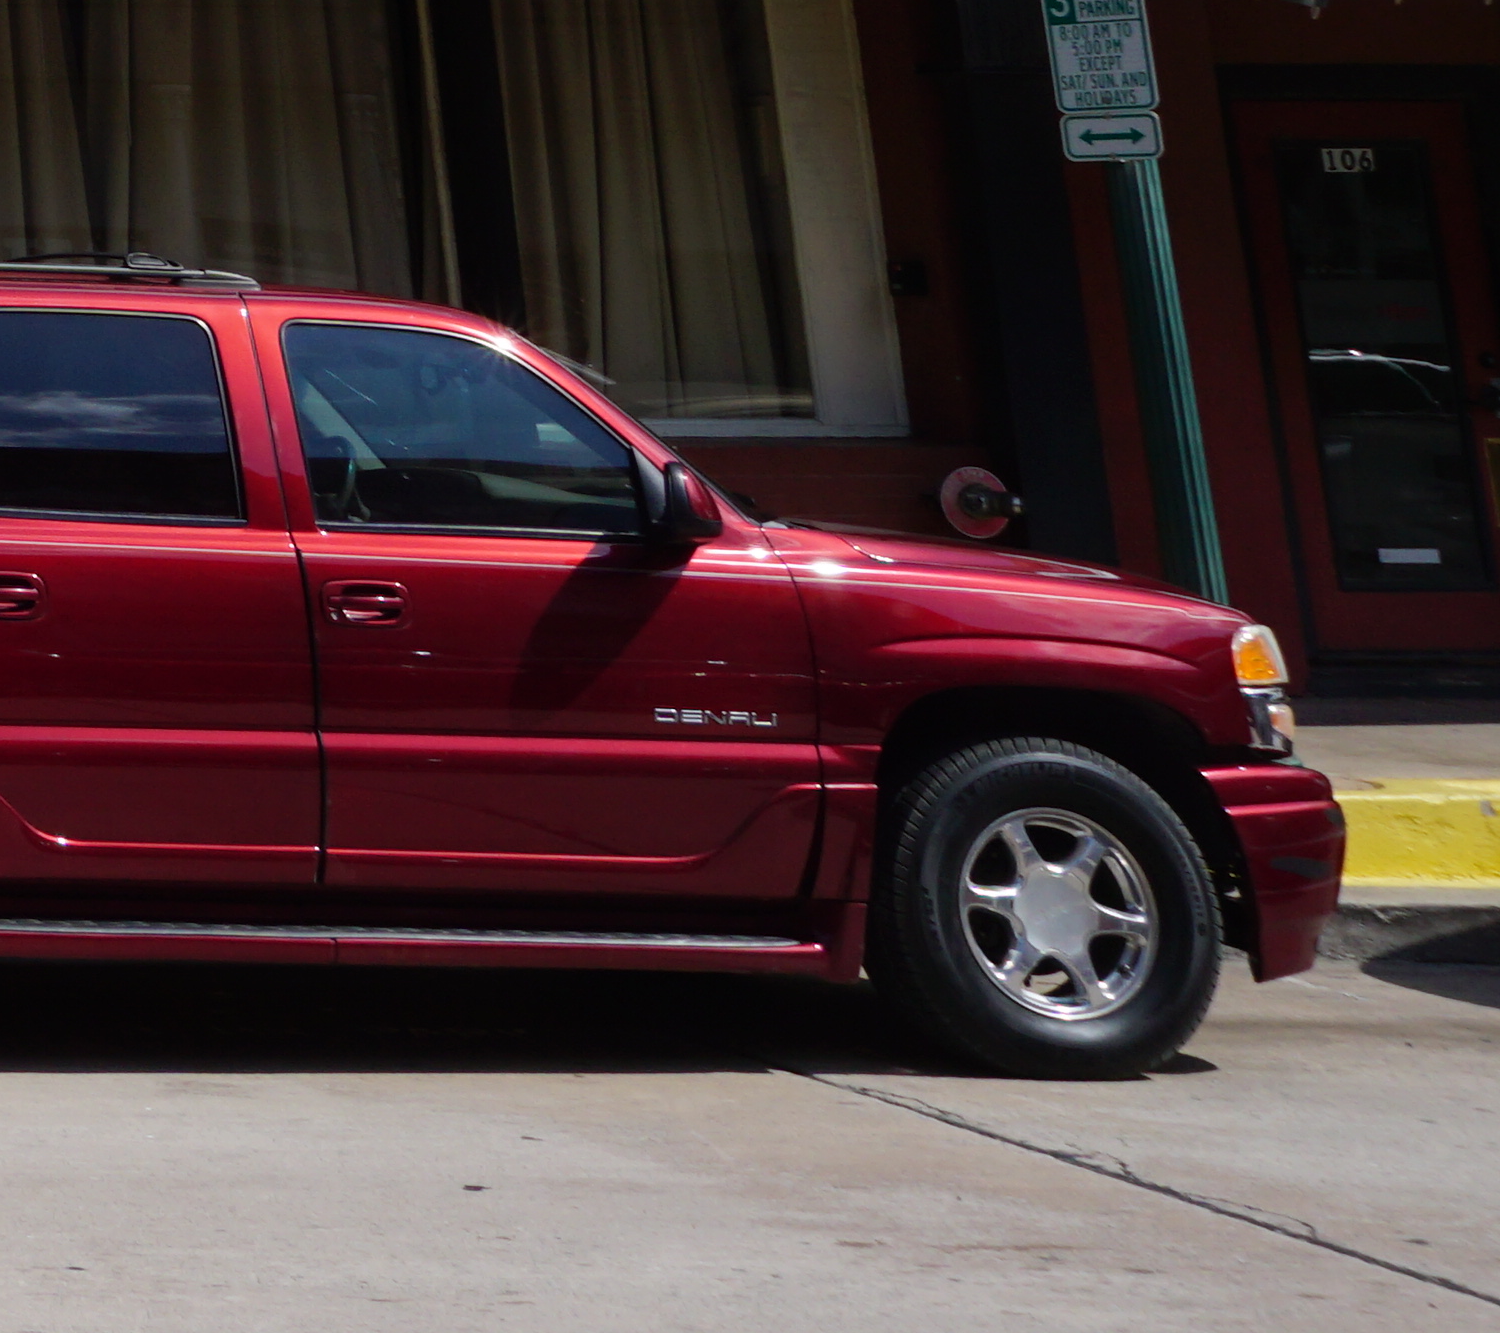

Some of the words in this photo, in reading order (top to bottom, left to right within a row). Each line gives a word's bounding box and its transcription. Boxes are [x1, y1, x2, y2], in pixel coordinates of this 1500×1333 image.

[1059, 24, 1088, 41] 8:00
[1093, 24, 1111, 38] AM
[1116, 22, 1132, 37] TO
[1105, 39, 1123, 54] PM
[1078, 55, 1121, 72] EXCEPT
[1121, 72, 1148, 86] AND
[1326, 149, 1373, 172] 106
[653, 707, 778, 727] DENALI
